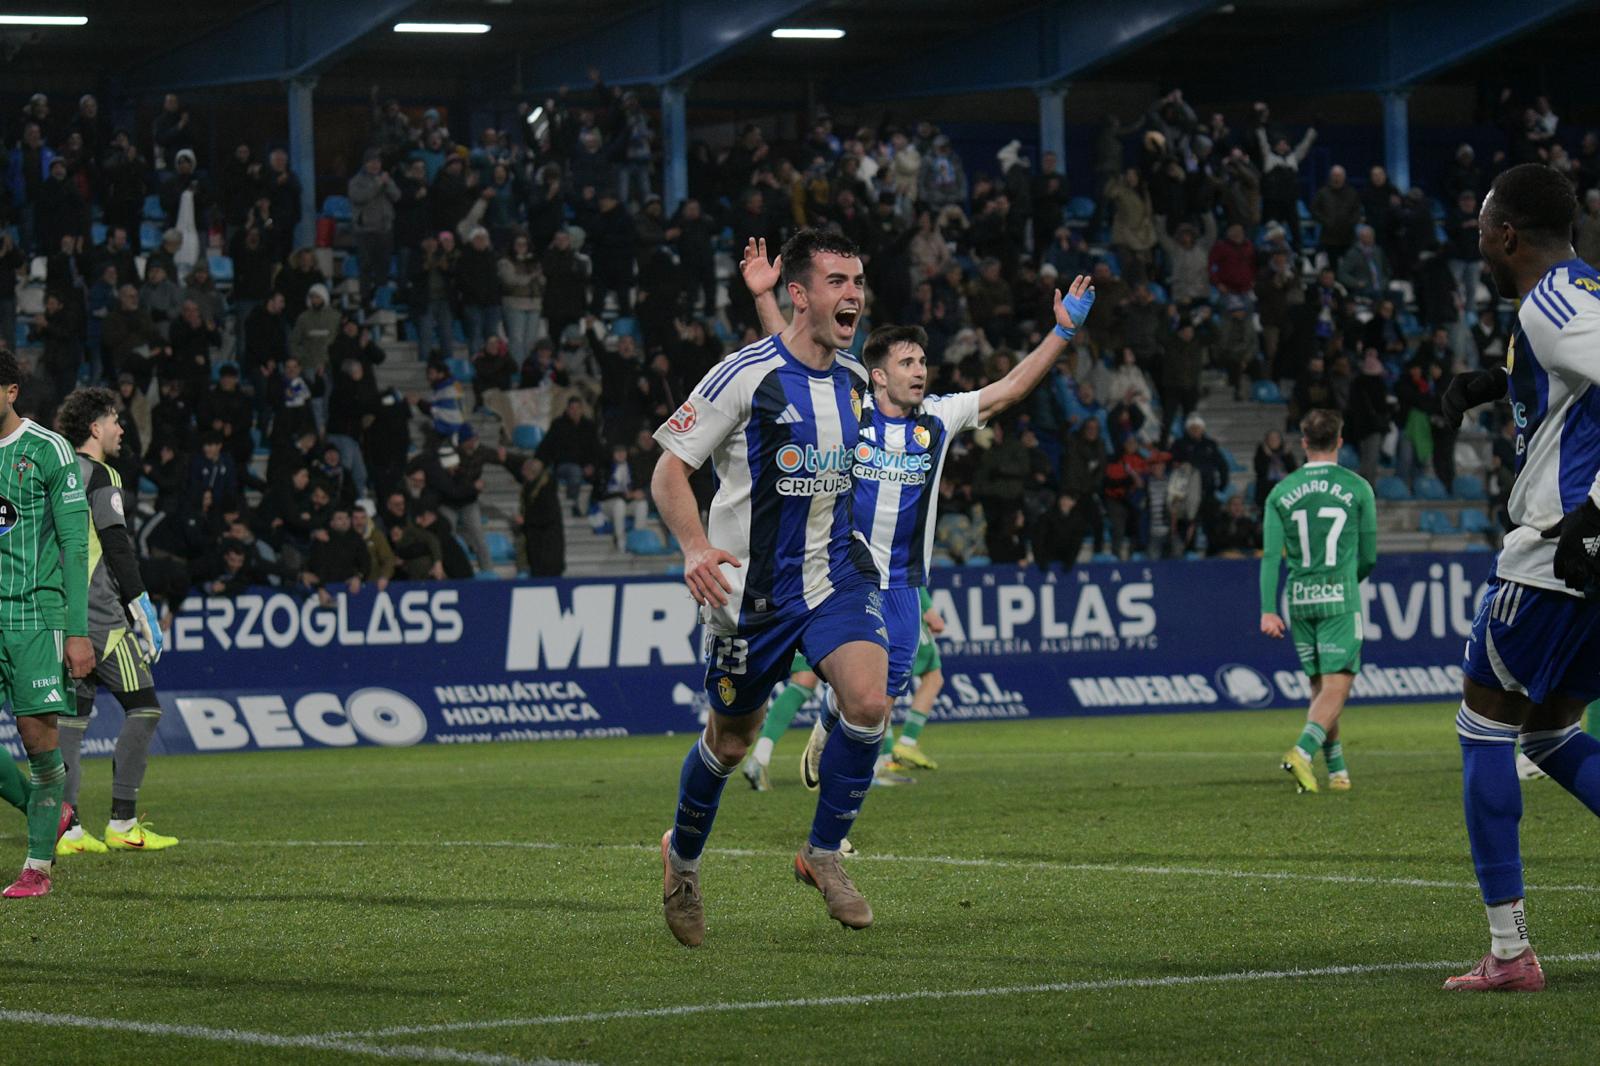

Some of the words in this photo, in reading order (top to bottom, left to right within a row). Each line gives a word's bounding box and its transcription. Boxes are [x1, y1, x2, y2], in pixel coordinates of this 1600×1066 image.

[805, 444, 853, 472] tvite
[874, 447, 931, 471] tvitec
[777, 475, 852, 495] CRICURS
[853, 464, 925, 484] CRICURSA
[1330, 483, 1353, 507] R.A.
[1291, 507, 1347, 567] 17
[927, 568, 1153, 587] ENTANAS
[931, 582, 1157, 642] ALPLAS
[1358, 563, 1488, 641] tvit
[505, 583, 705, 671] MR
[716, 637, 749, 674] 23
[941, 637, 1032, 655] RPINTERÍA
[1040, 637, 1120, 653] ALUMINIO
[434, 680, 588, 704] NEUMÁTICA
[951, 673, 1023, 704] S.L.
[1069, 674, 1218, 707] MADERAS
[1274, 663, 1464, 700] CAAÑEIRAS
[174, 687, 428, 750] BECO
[441, 702, 602, 727] HIDRÁULICA
